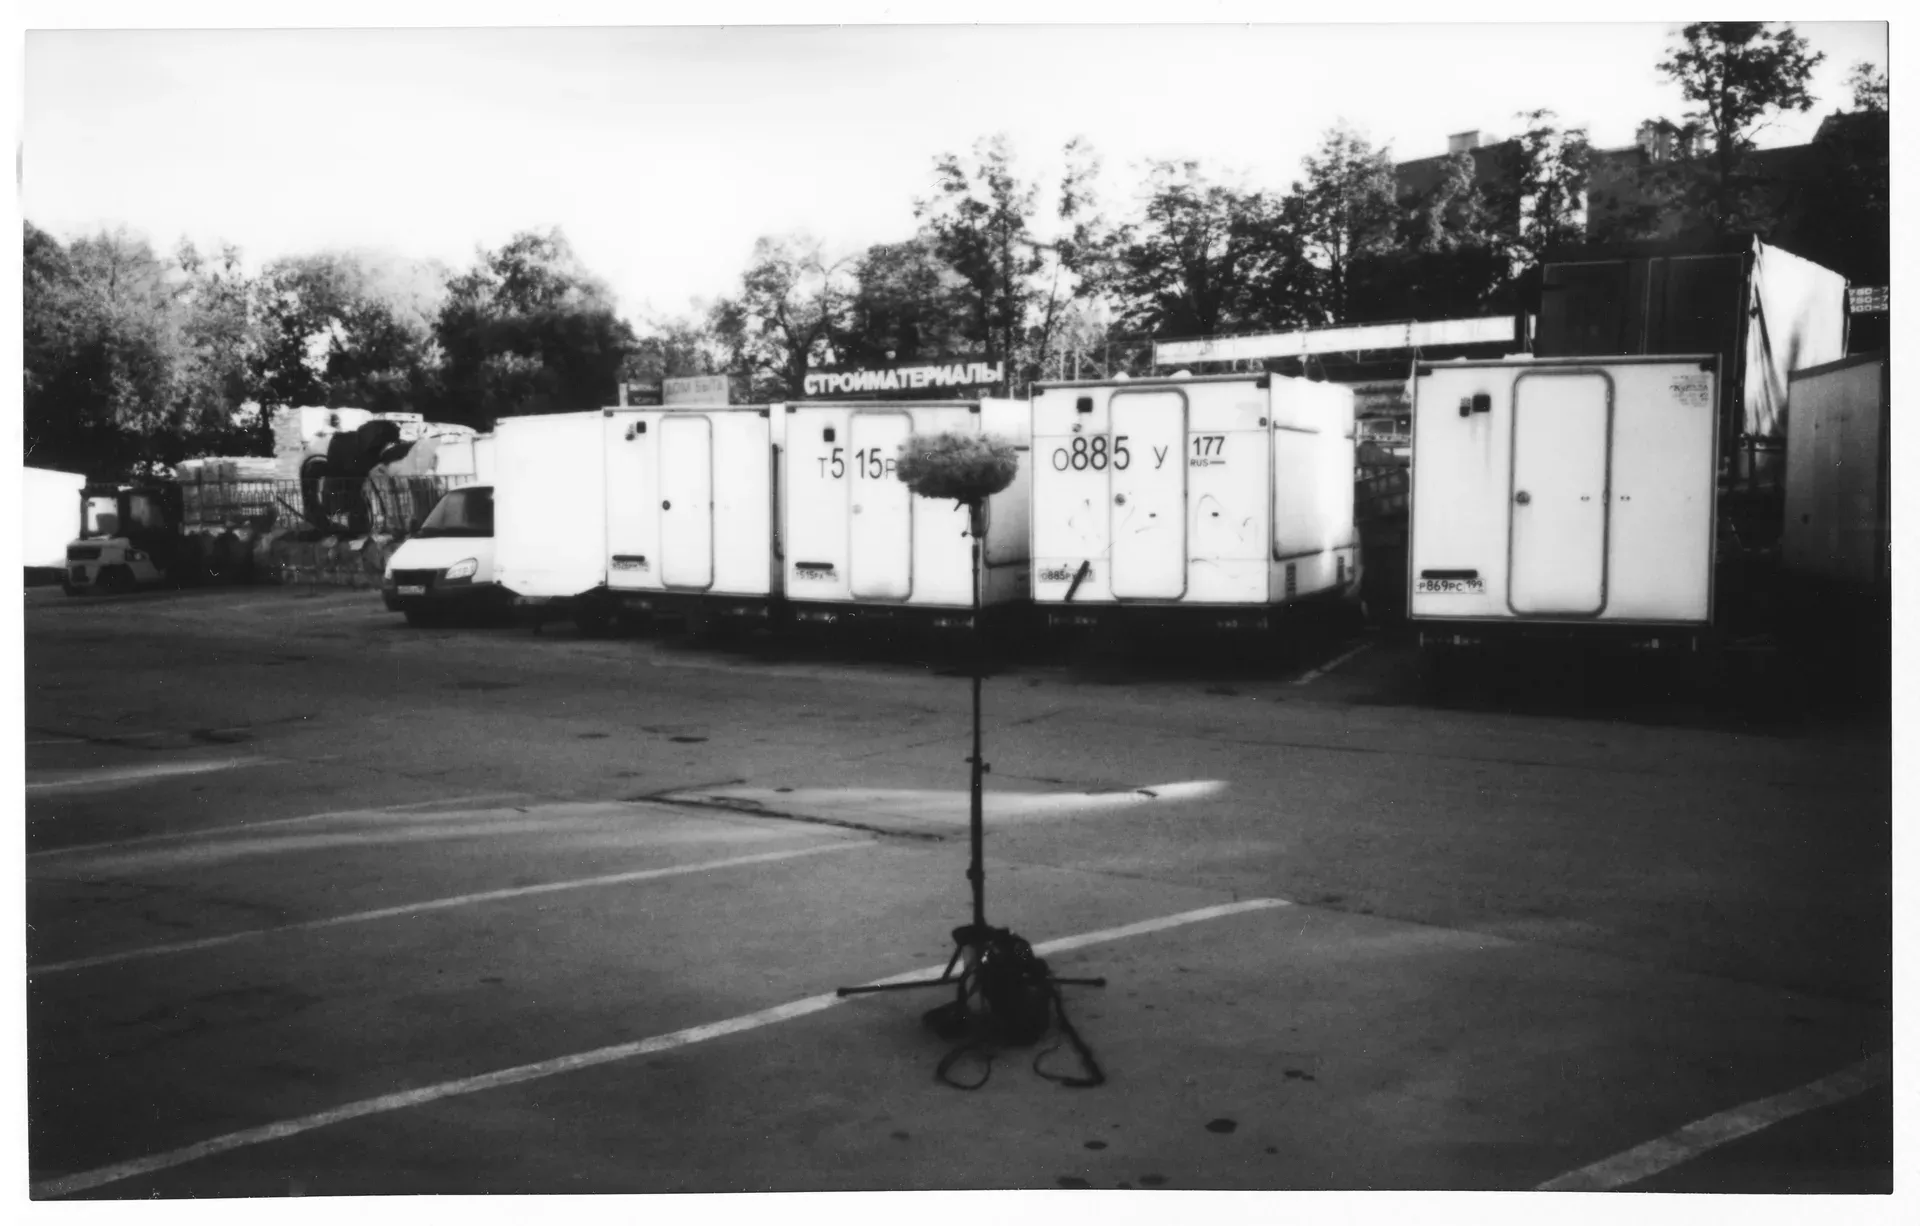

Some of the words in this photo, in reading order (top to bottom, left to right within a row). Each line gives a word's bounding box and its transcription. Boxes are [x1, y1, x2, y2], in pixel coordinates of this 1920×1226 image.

[804, 361, 1004, 395] СТРОЙМАТЕРИАЛЫ
[1193, 436, 1225, 455] 177
[1190, 459, 1209, 467] RUS
